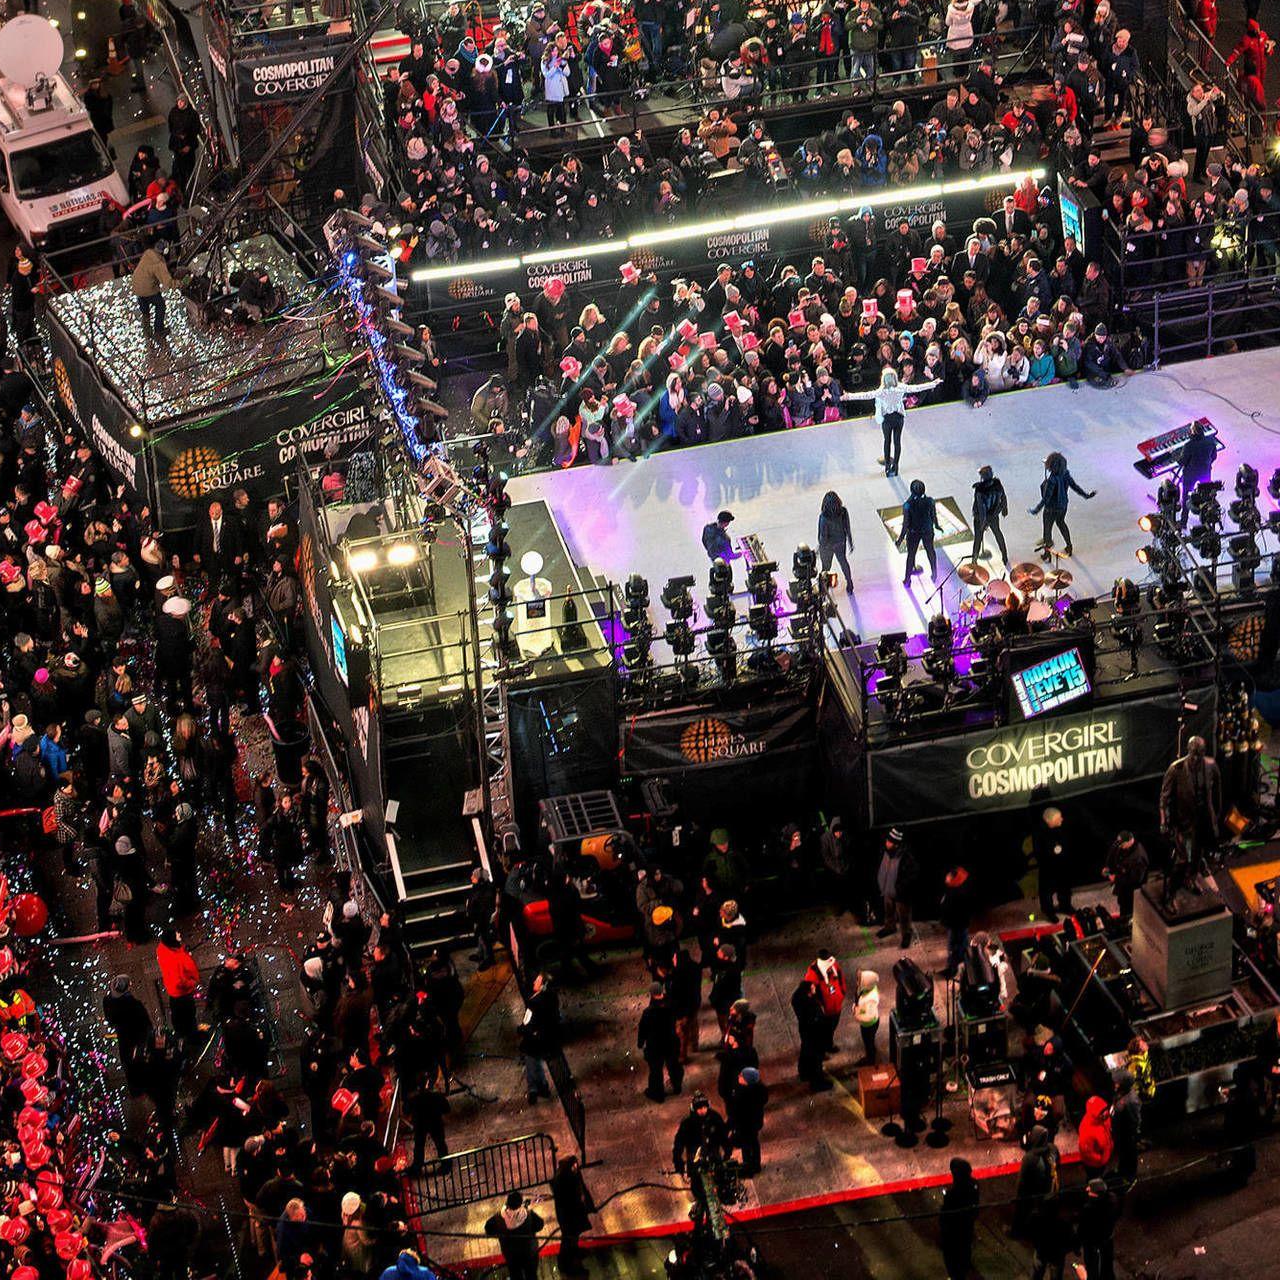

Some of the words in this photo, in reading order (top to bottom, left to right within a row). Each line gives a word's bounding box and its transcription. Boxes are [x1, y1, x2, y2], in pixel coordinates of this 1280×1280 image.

[252, 56, 334, 82] COSMOPOLITAN
[706, 228, 770, 248] COSMOPOLITAN
[707, 243, 771, 261] COVERGIRL
[526, 258, 591, 276] COVERGIRL
[275, 404, 369, 447] COVERGIRL
[191, 459, 239, 484] TIMES
[1034, 674, 1064, 699] EVE
[703, 733, 746, 748] TIMES
[711, 741, 767, 759] SQUARE
[966, 721, 1122, 770] COVERGIRL
[969, 745, 1123, 800] COSMOPOLITAN
